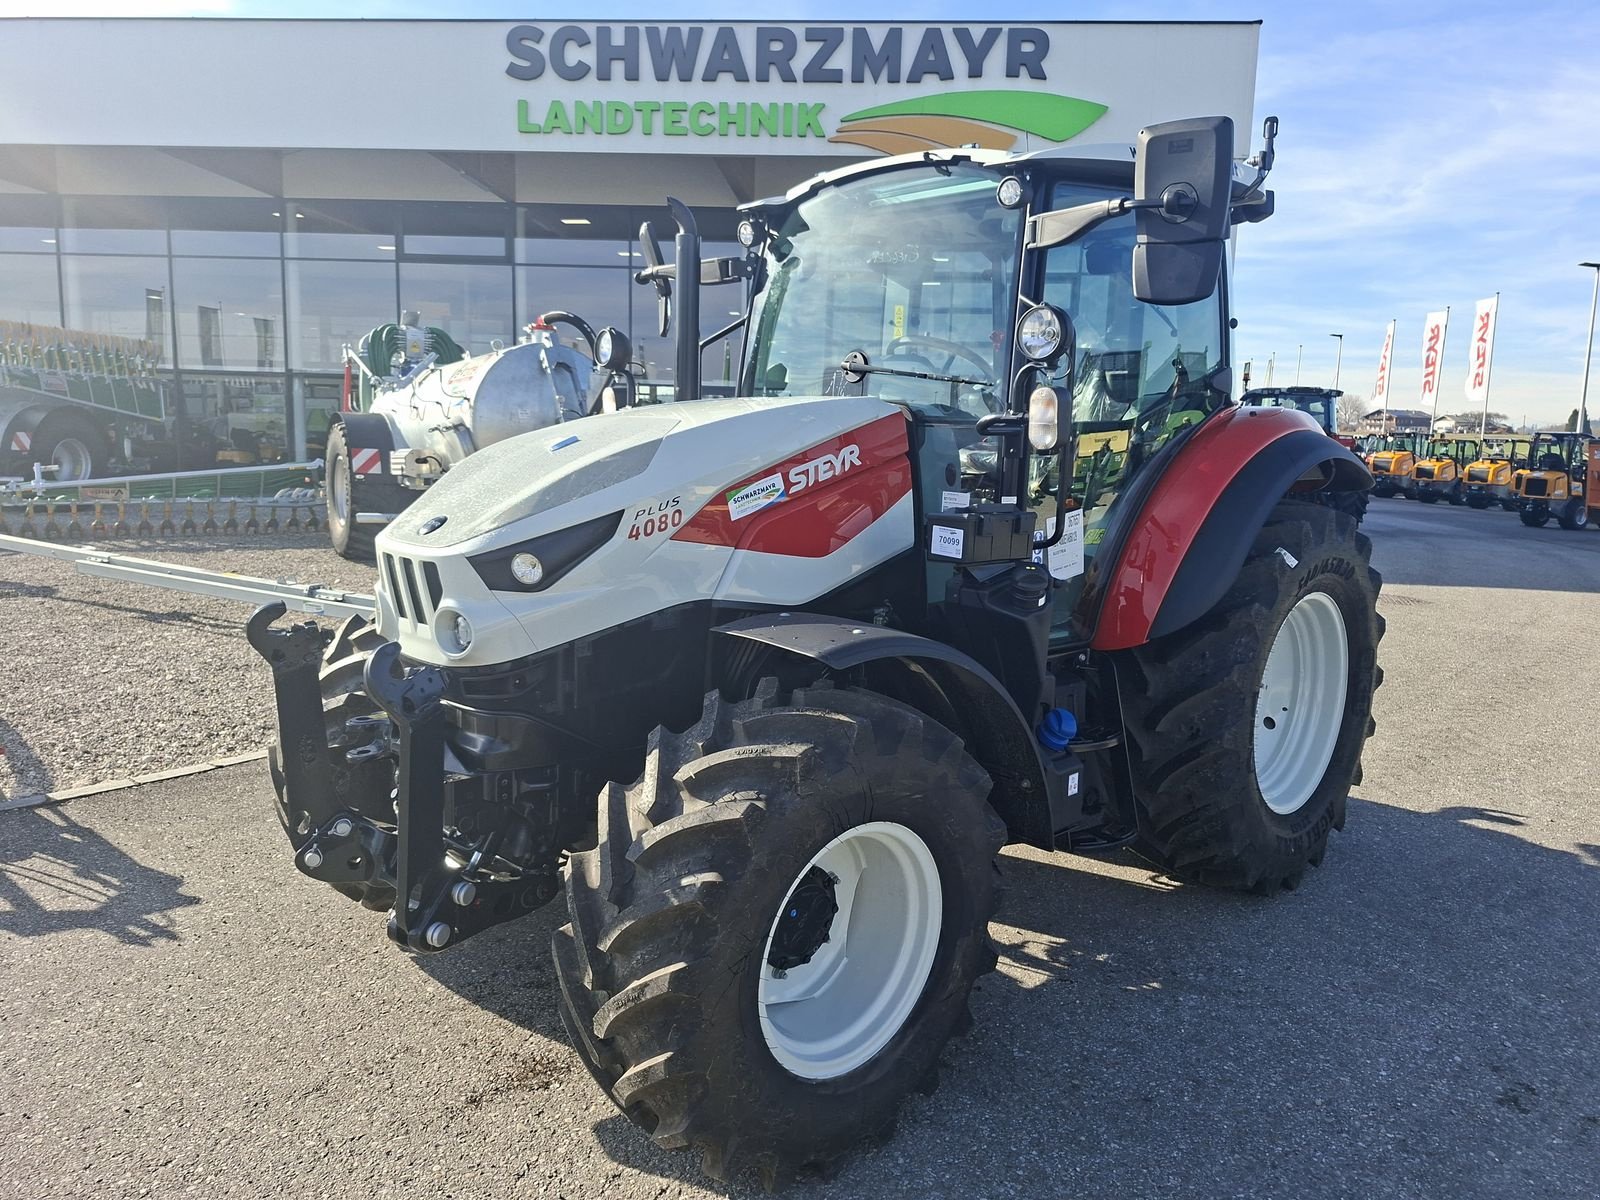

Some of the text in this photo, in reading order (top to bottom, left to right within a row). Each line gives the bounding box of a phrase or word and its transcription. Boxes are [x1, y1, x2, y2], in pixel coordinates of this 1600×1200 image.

[505, 25, 1050, 84] SCHWARZMAYR
[517, 99, 826, 138] LANDTECHNIK
[789, 444, 862, 494] STEYR
[634, 495, 681, 520] PLUS
[733, 482, 776, 505] SCHWARZMAYR
[628, 509, 683, 540] 4080
[939, 535, 960, 546] 70099
